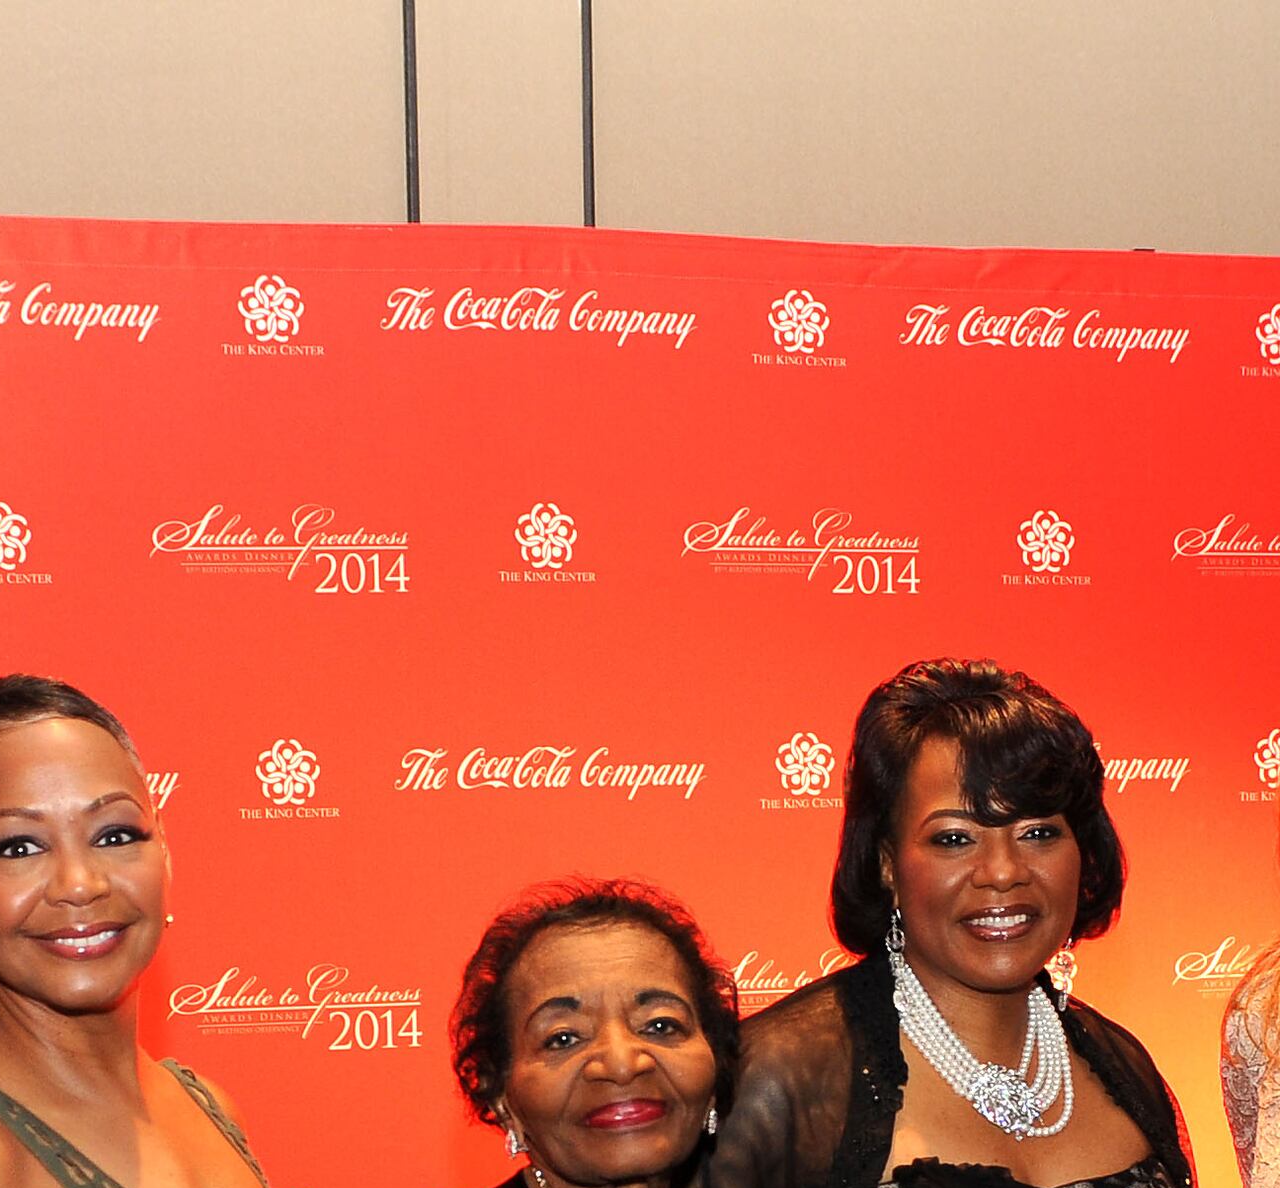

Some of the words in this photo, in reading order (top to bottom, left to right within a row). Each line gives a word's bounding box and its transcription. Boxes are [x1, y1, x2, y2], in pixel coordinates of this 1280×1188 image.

[20, 282, 159, 343] Company
[380, 287, 435, 331] The
[568, 290, 696, 350] Company
[220, 342, 246, 357] THE
[246, 343, 278, 357] KING
[279, 343, 326, 358] CENTER
[899, 304, 950, 346] The
[1072, 309, 1190, 364] Company
[750, 352, 775, 366] THE
[775, 352, 803, 367] KING
[804, 354, 848, 368] CENTER
[1238, 365, 1261, 378] THE
[149, 504, 258, 558] Salute
[264, 528, 285, 545] to
[287, 503, 408, 581] Greatness
[681, 507, 783, 557] Salute
[786, 530, 805, 547] to
[808, 508, 920, 581] Greatness
[1171, 513, 1263, 562] Salute
[4, 571, 55, 586] CENTER
[314, 552, 411, 594] 2014
[497, 570, 522, 583] THE
[522, 570, 552, 583] KING
[552, 571, 598, 583] CENTER
[832, 555, 921, 595] 2014
[1000, 573, 1023, 586] THE
[1023, 573, 1050, 586] KING
[1050, 574, 1093, 586] CENTER
[395, 748, 449, 791] The
[580, 746, 705, 801] Company
[1102, 741, 1191, 793] mpany
[238, 807, 264, 820] THE
[264, 807, 296, 820] KING
[296, 807, 342, 820] CENTER
[760, 799, 780, 809] THE
[783, 798, 809, 808] KING
[167, 966, 275, 1020] Salute
[279, 987, 299, 1006] to
[302, 963, 422, 1040] Greatness
[328, 1009, 423, 1051] 2014
